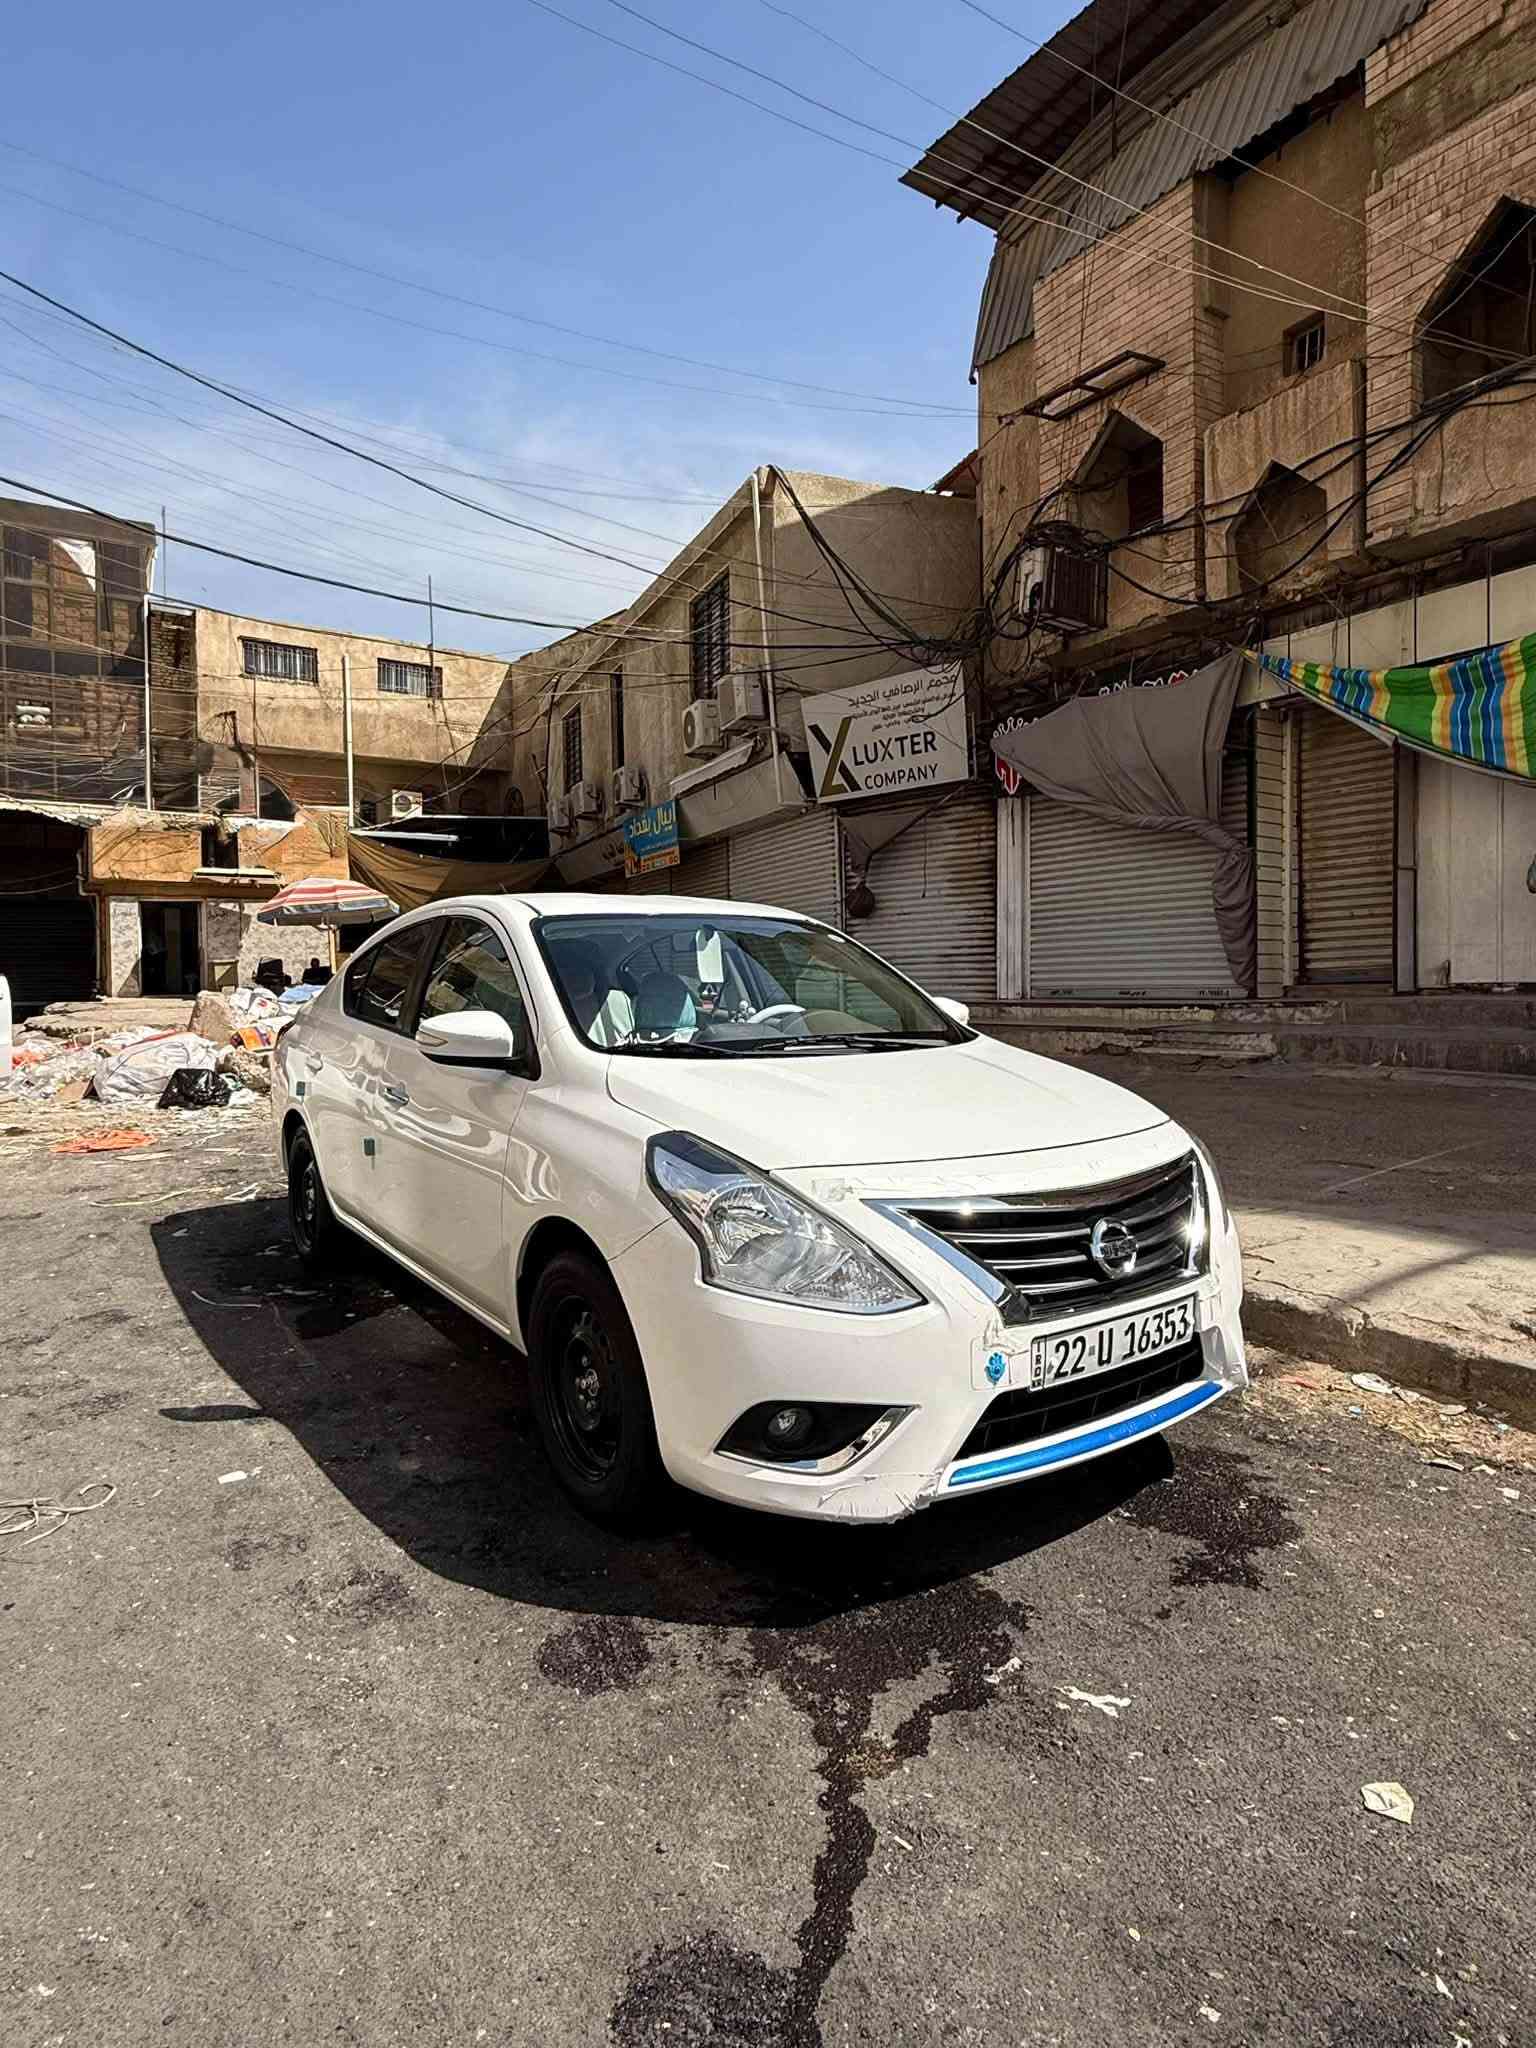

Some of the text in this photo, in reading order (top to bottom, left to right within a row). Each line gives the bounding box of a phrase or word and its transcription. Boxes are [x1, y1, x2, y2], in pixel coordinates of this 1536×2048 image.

[848, 689, 880, 707] الجديد
[853, 731, 938, 766] LUXTER
[864, 763, 939, 790] COMPANY
[1053, 1335, 1087, 1379] 22
[1122, 1303, 1189, 1361] 16353
